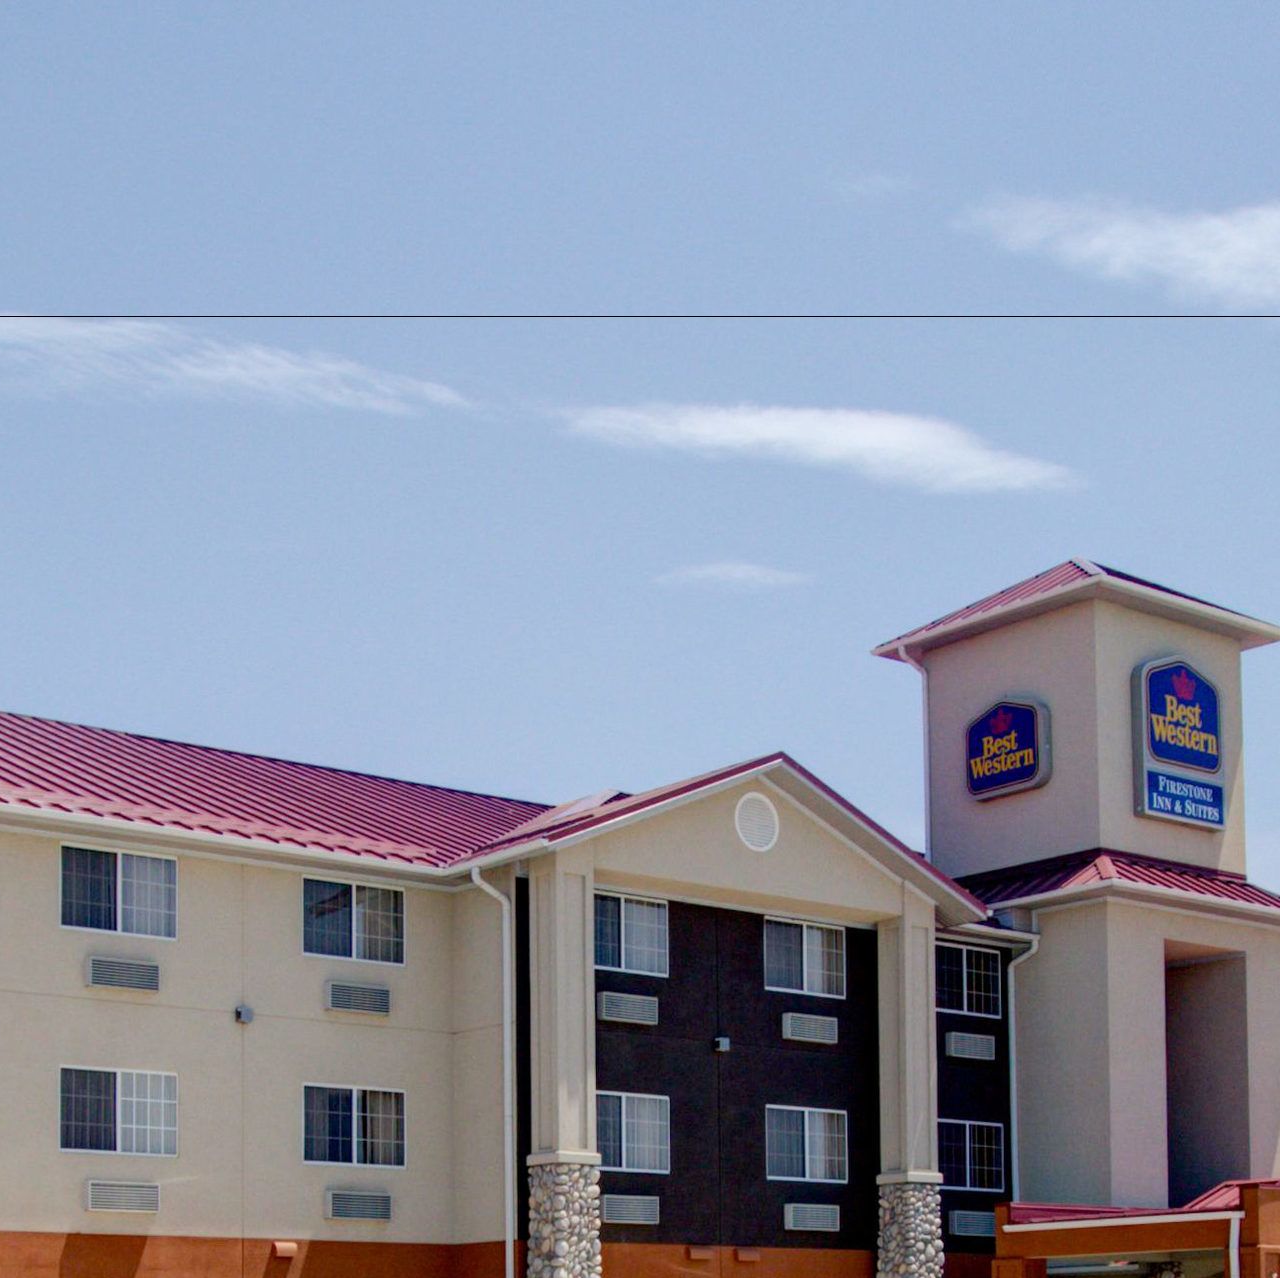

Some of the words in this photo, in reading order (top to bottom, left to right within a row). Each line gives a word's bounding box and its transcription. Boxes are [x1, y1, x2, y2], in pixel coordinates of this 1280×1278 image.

[1165, 694, 1203, 729] Best
[982, 730, 1018, 758] Best
[1151, 713, 1218, 755] Western
[970, 748, 1034, 779] Western
[1158, 775, 1213, 803] FIRESTONE
[1152, 792, 1172, 811] INN
[1174, 799, 1183, 814] &
[1184, 799, 1220, 821] SUITES
